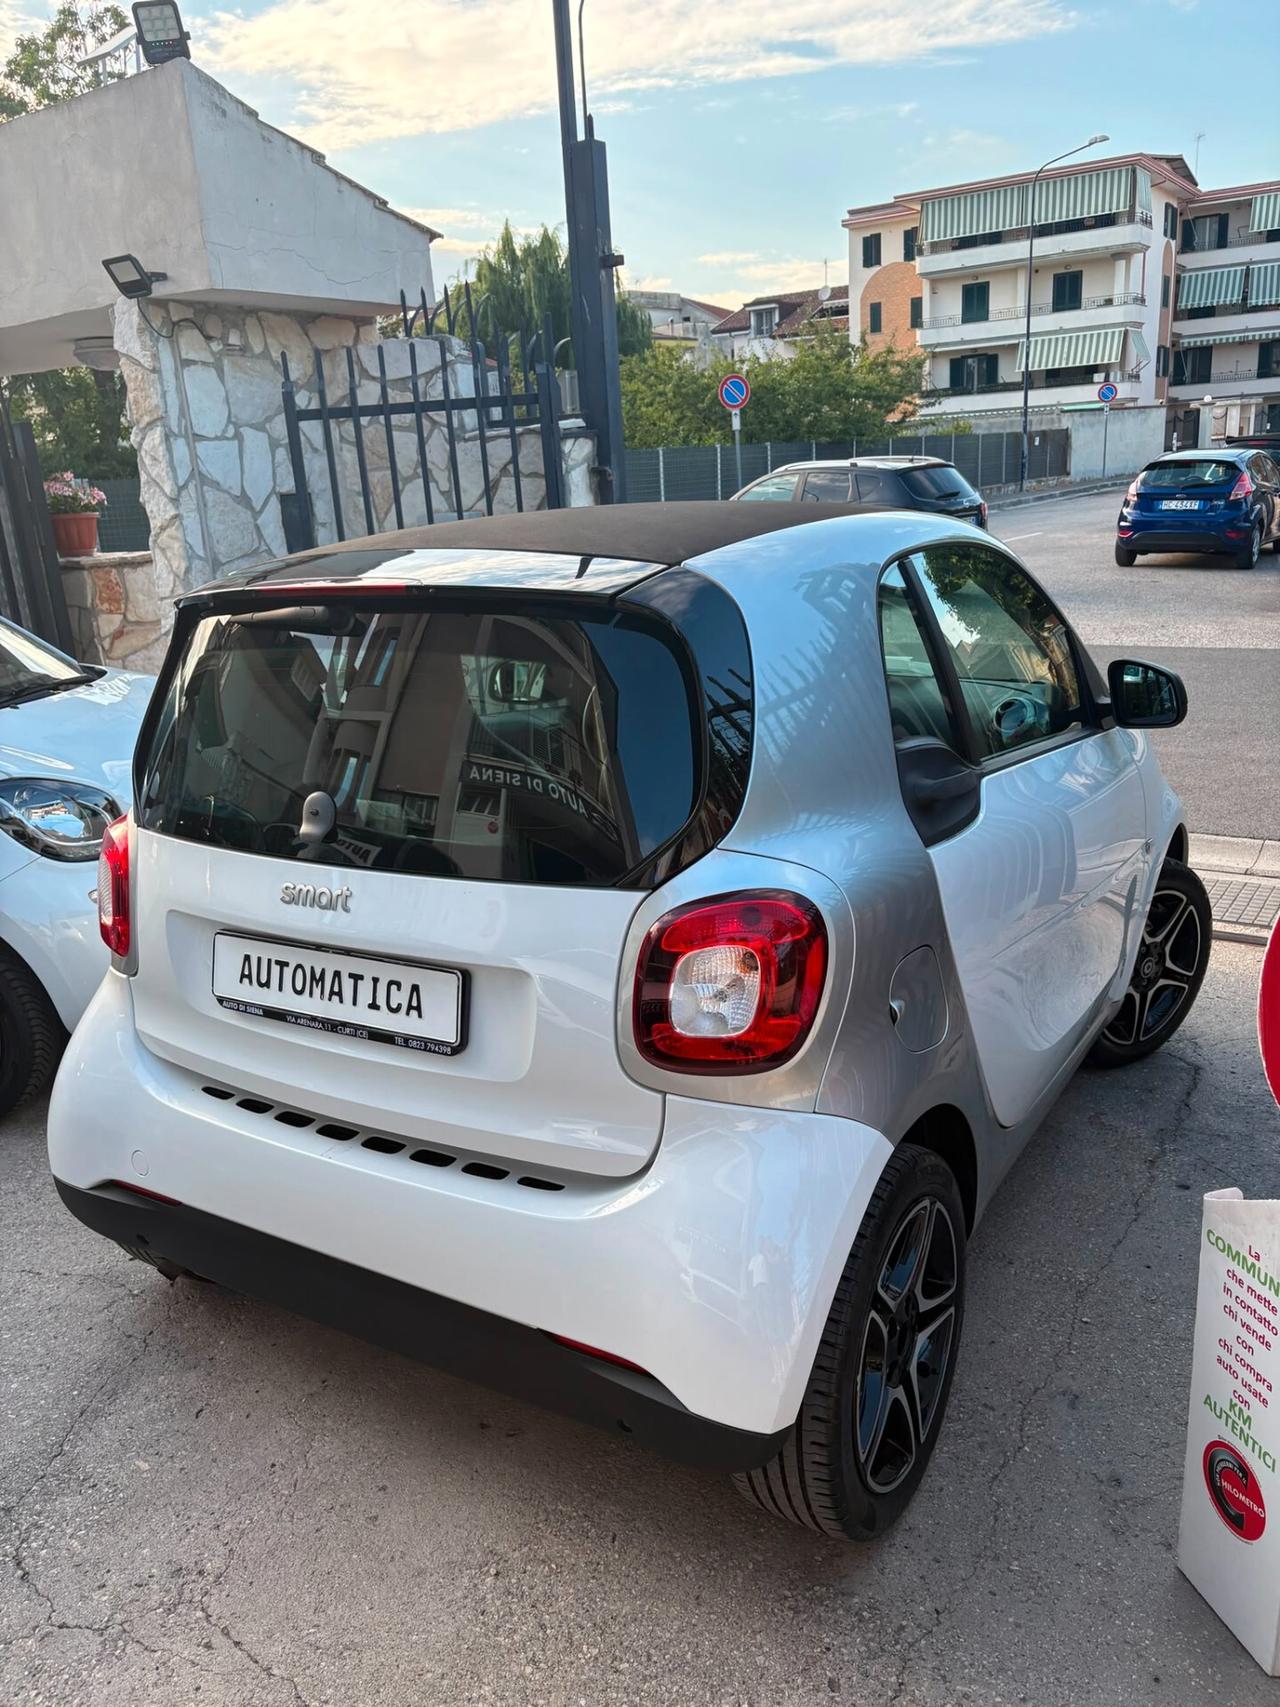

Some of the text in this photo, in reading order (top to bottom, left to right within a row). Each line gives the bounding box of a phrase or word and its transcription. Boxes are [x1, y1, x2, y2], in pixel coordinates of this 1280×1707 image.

[280, 882, 352, 913] smart
[239, 954, 423, 1019] AUTOMATICA
[222, 1000, 238, 1011] AUTO
[286, 1015, 296, 1024] VIA
[337, 1025, 356, 1037] CURTI
[408, 1039, 425, 1050] 0823
[427, 1042, 452, 1055] 794398
[1248, 1245, 1261, 1262] La
[1226, 1268, 1278, 1316] che mette
[1223, 1282, 1278, 1336] in contatto
[1223, 1304, 1272, 1351] chi vende
[1236, 1335, 1254, 1356] con
[1216, 1354, 1269, 1408] auto usate
[1218, 1338, 1273, 1392] chi compra
[1228, 1398, 1253, 1431] KM
[1232, 1389, 1251, 1411] con
[1203, 1393, 1276, 1473] AUTENTICI
